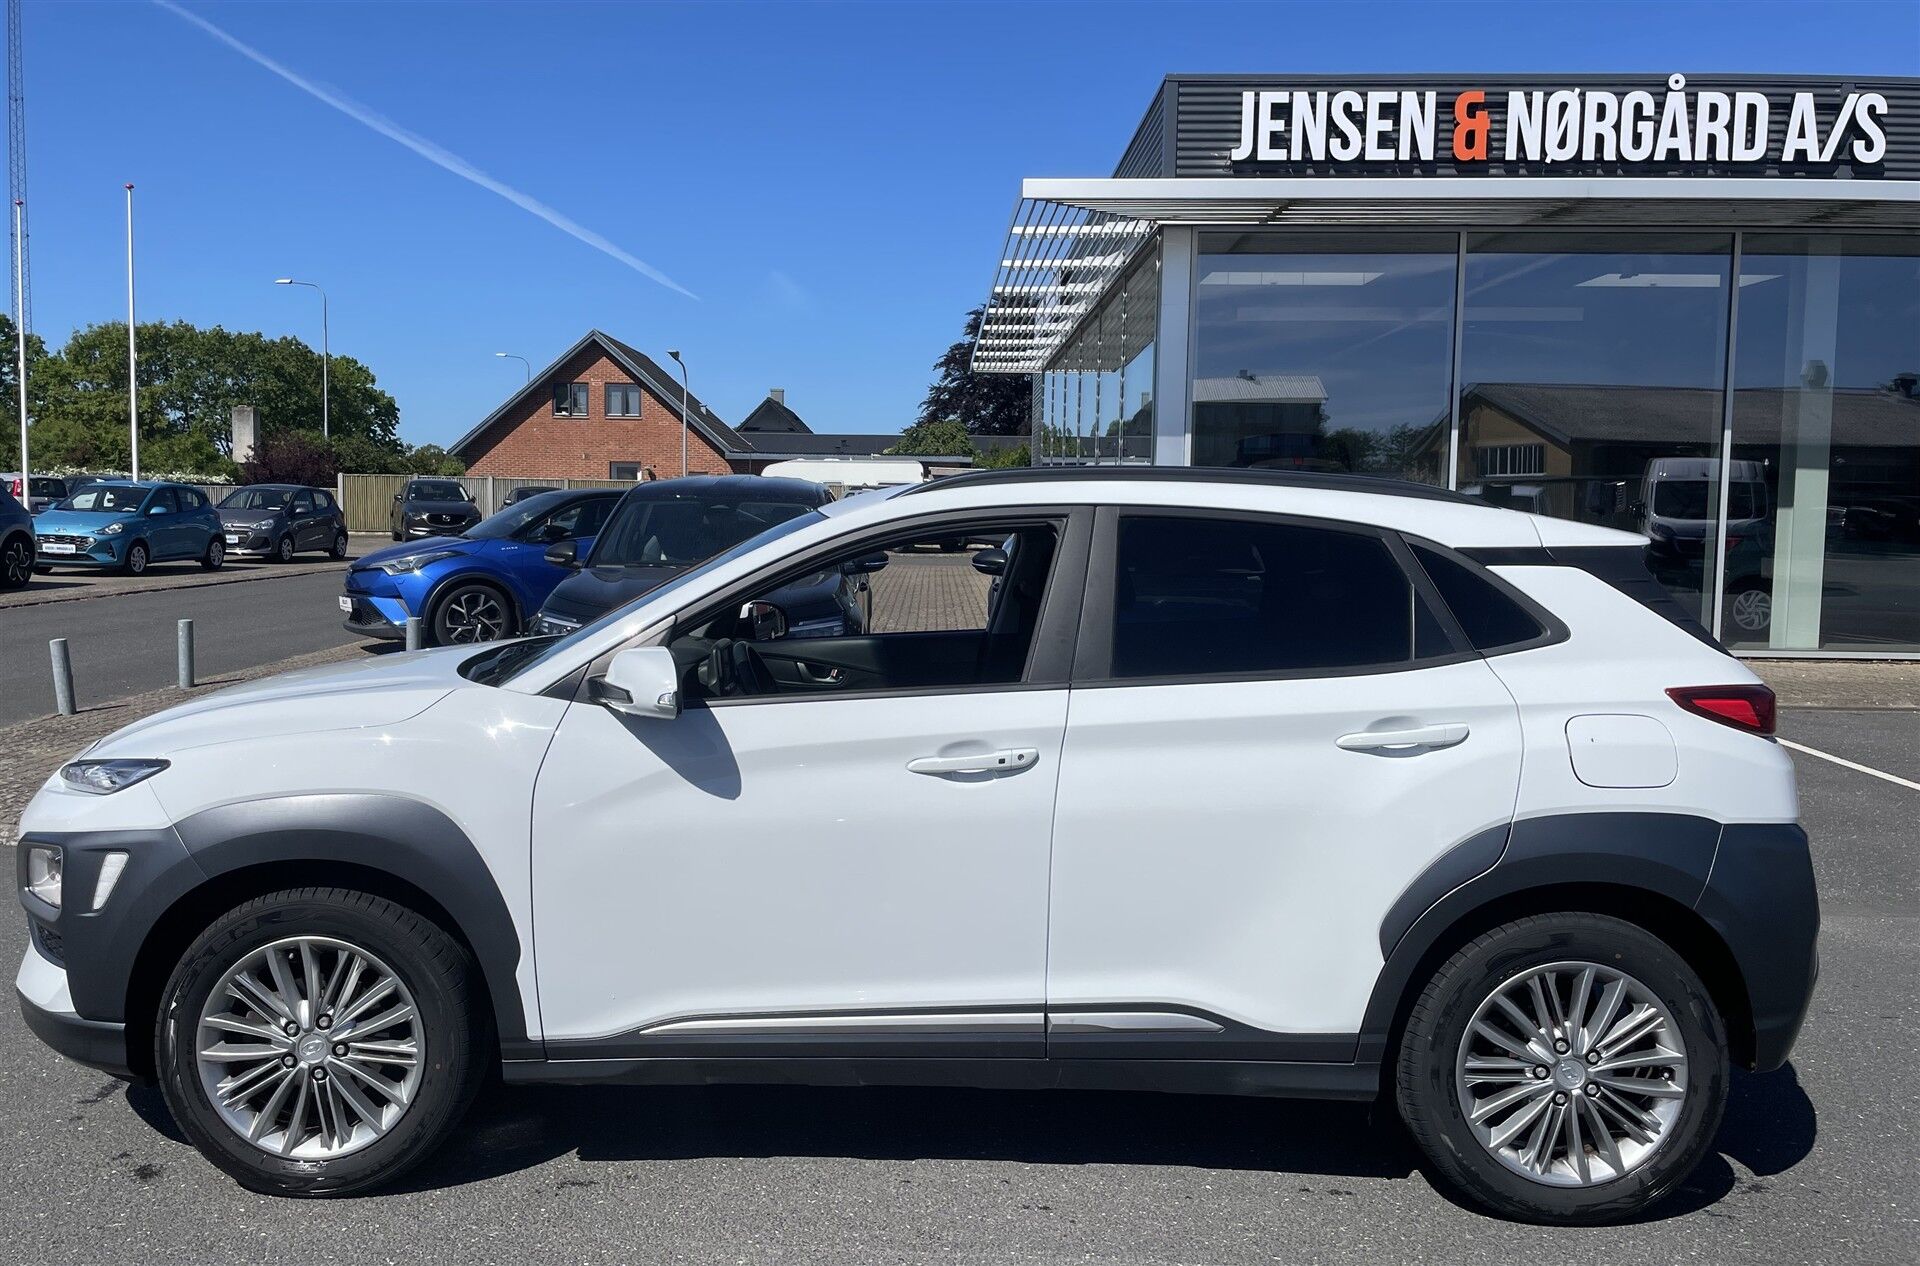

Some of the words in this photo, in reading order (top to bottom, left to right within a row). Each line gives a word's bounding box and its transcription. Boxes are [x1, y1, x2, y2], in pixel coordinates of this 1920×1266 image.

[1231, 91, 1437, 161] JENSEN
[1452, 90, 1491, 161] &
[1505, 73, 1769, 164] NØRGÅRD
[1781, 92, 1888, 163] A/S
